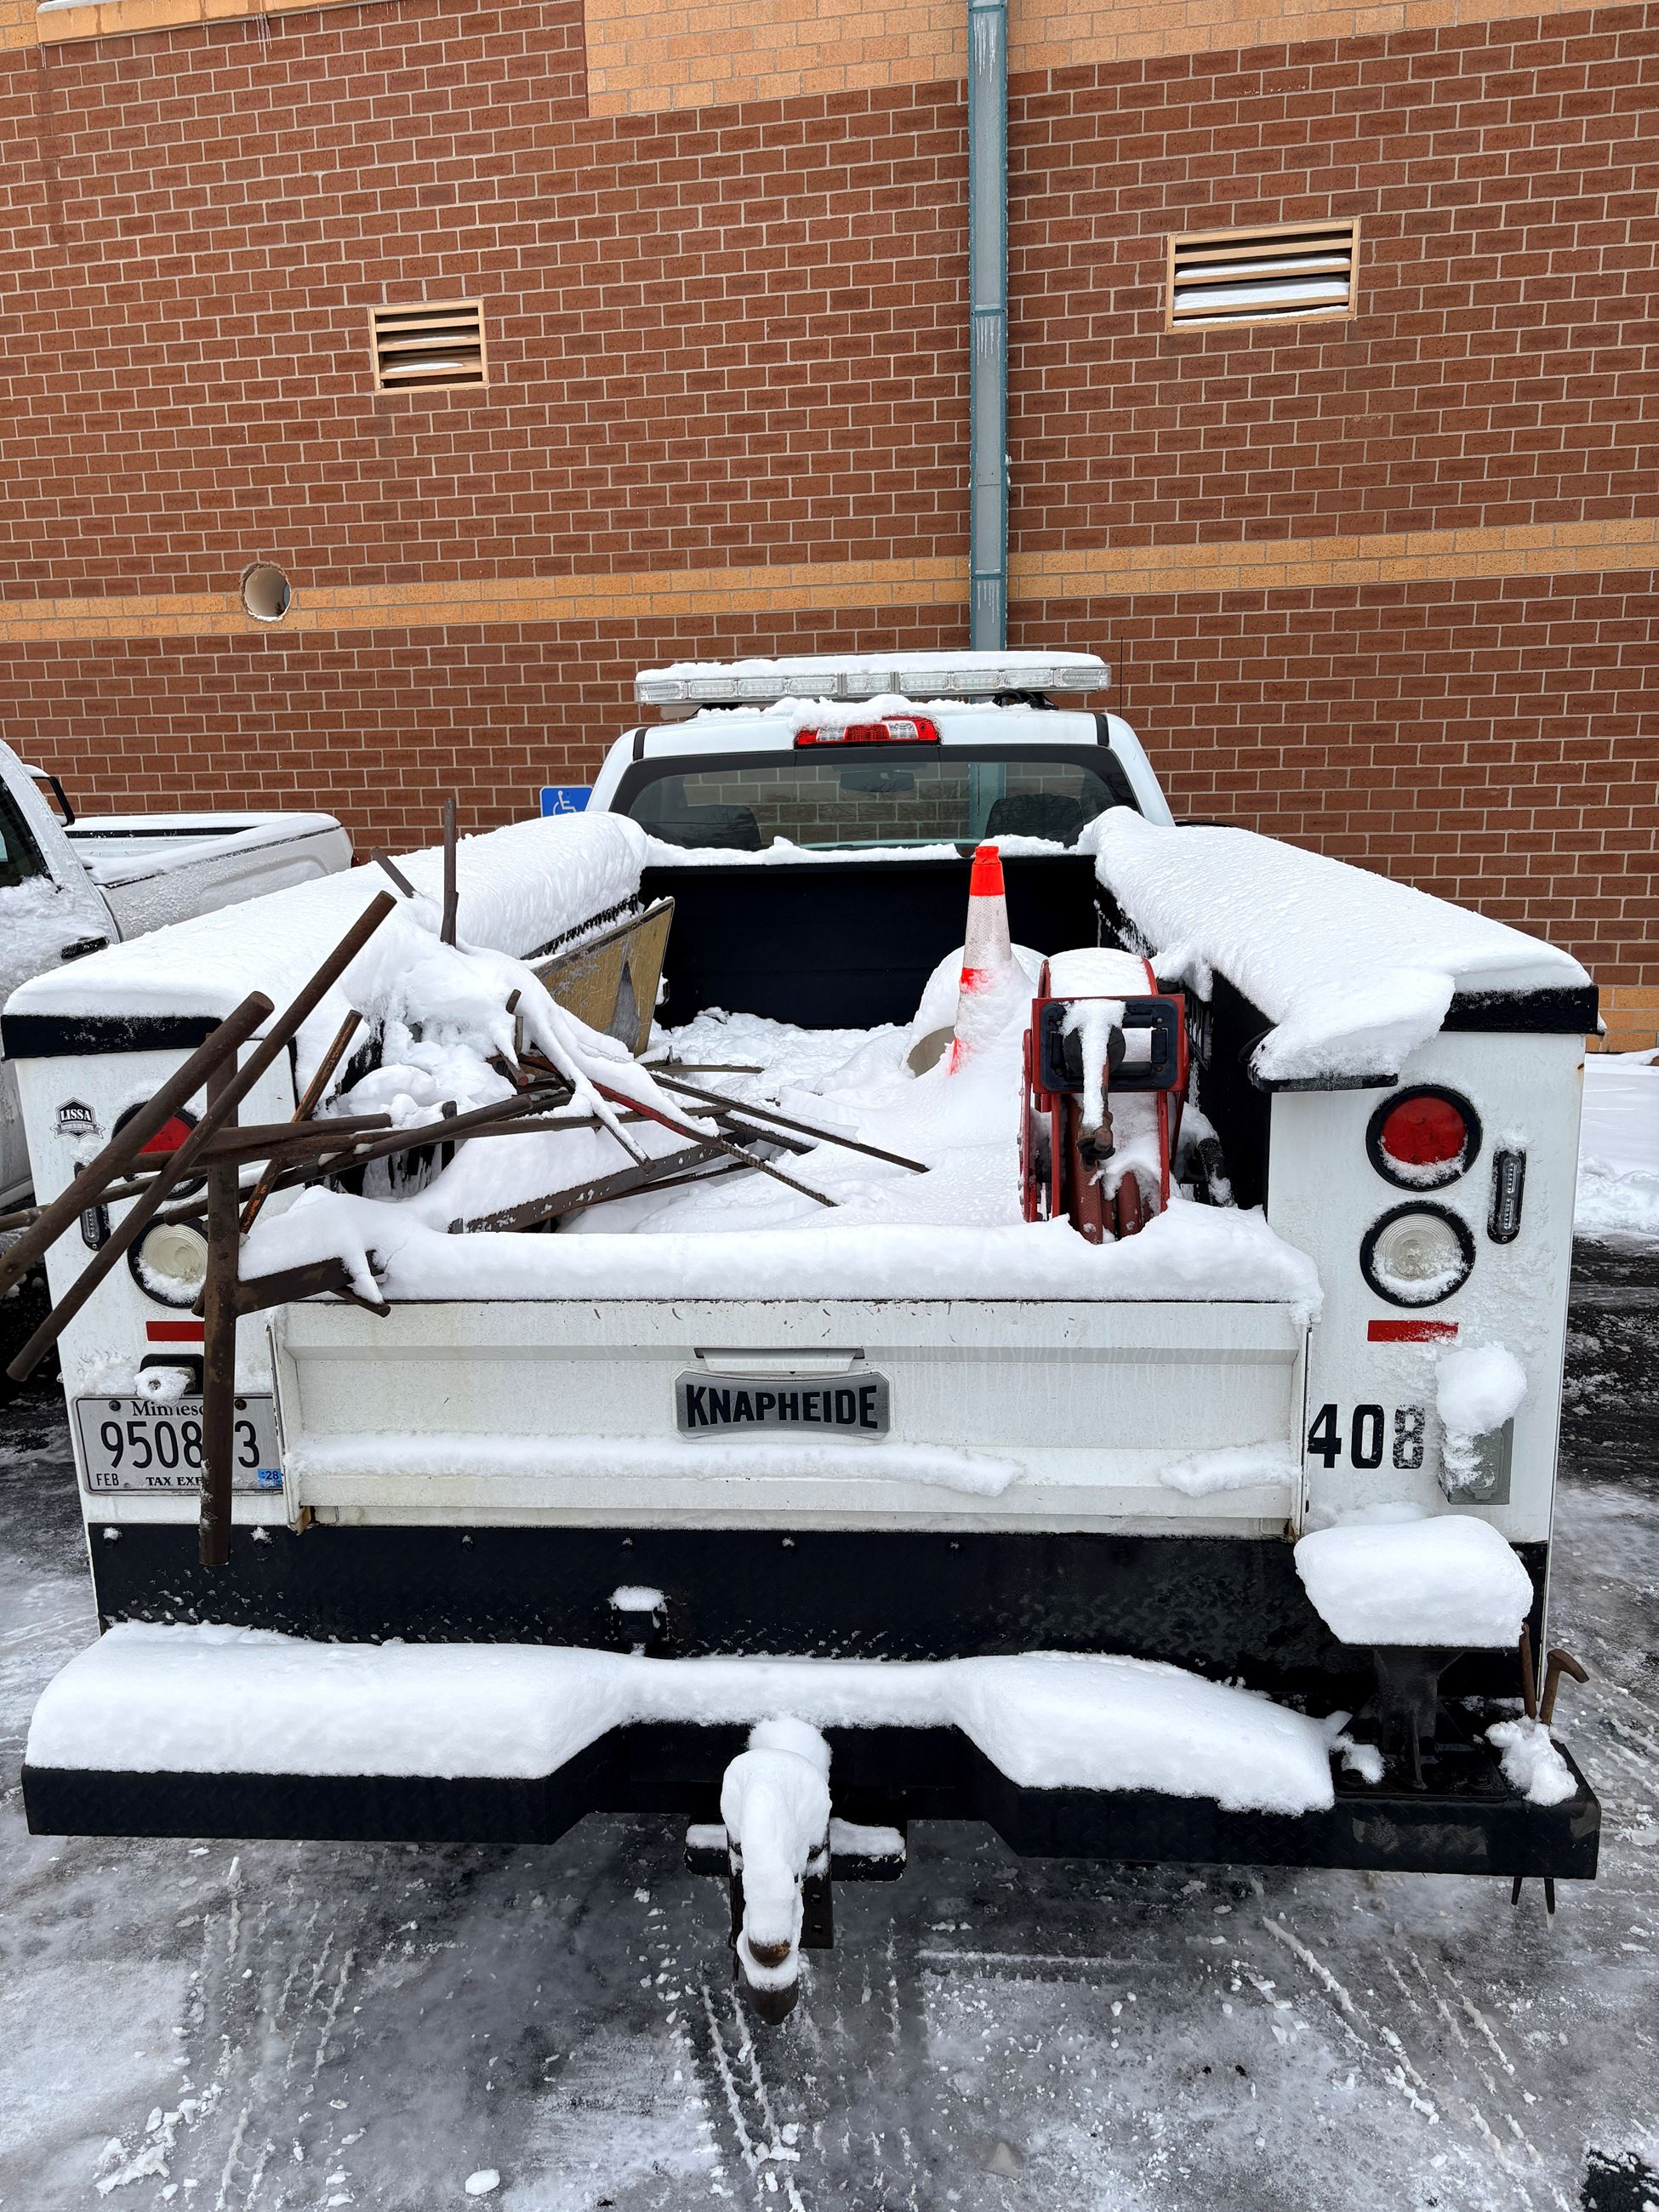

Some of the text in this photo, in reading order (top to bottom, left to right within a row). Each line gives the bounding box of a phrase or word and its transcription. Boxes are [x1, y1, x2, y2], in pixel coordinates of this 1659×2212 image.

[60, 1109, 92, 1121] LISSA
[130, 1400, 204, 1417] Minnes
[686, 1383, 878, 1429] KNAPHEIDE
[100, 1420, 260, 1468] 95083
[1308, 1404, 1425, 1469] 408
[96, 1473, 119, 1486] FEB
[145, 1476, 172, 1486] TAX
[265, 1470, 279, 1480] 28
